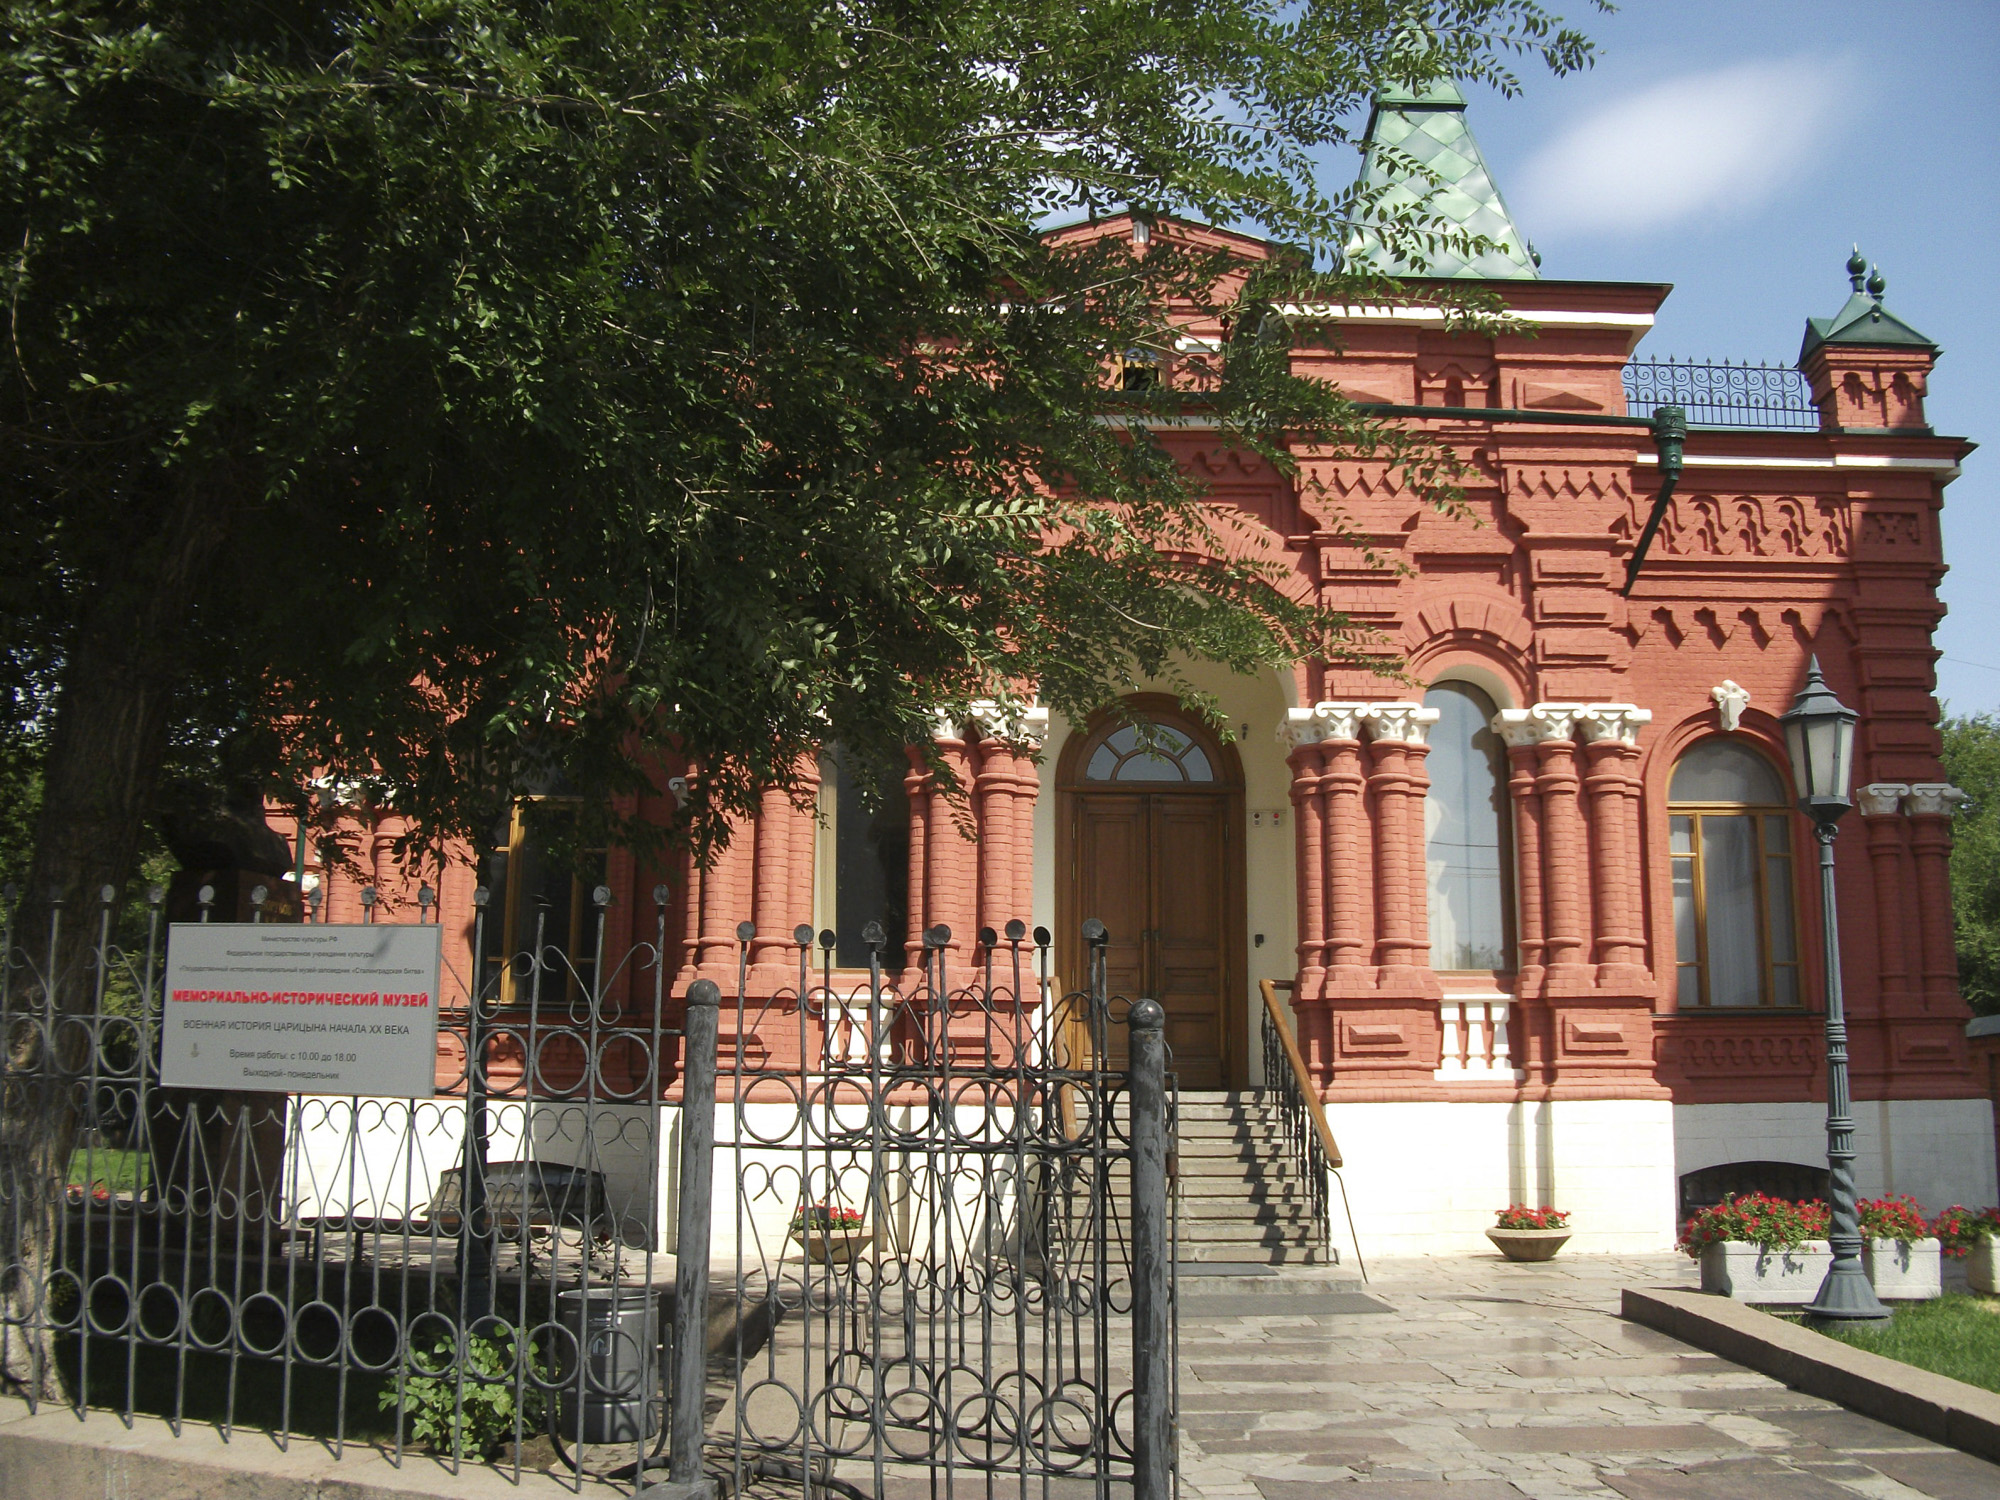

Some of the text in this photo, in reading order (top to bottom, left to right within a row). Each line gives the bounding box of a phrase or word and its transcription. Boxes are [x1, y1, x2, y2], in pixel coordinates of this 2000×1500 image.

[172, 990, 428, 1007] МЕМОРИАЛЬНО-ИСТОРИЧЕСКИЙ МУЗЕЙ
[183, 1019, 226, 1030] ВОЕННАЯ
[228, 1021, 271, 1031] ИСТОРИЯ
[273, 1022, 327, 1034] ЦАРИЦЫНА
[329, 1024, 367, 1034] НАЧАЛА
[384, 1025, 410, 1035] ВЕКА
[229, 1049, 255, 1059] Время
[257, 1050, 288, 1060] работы:
[298, 1052, 320, 1061] 10.00
[321, 1054, 332, 1062] до
[335, 1053, 357, 1062] 18.00
